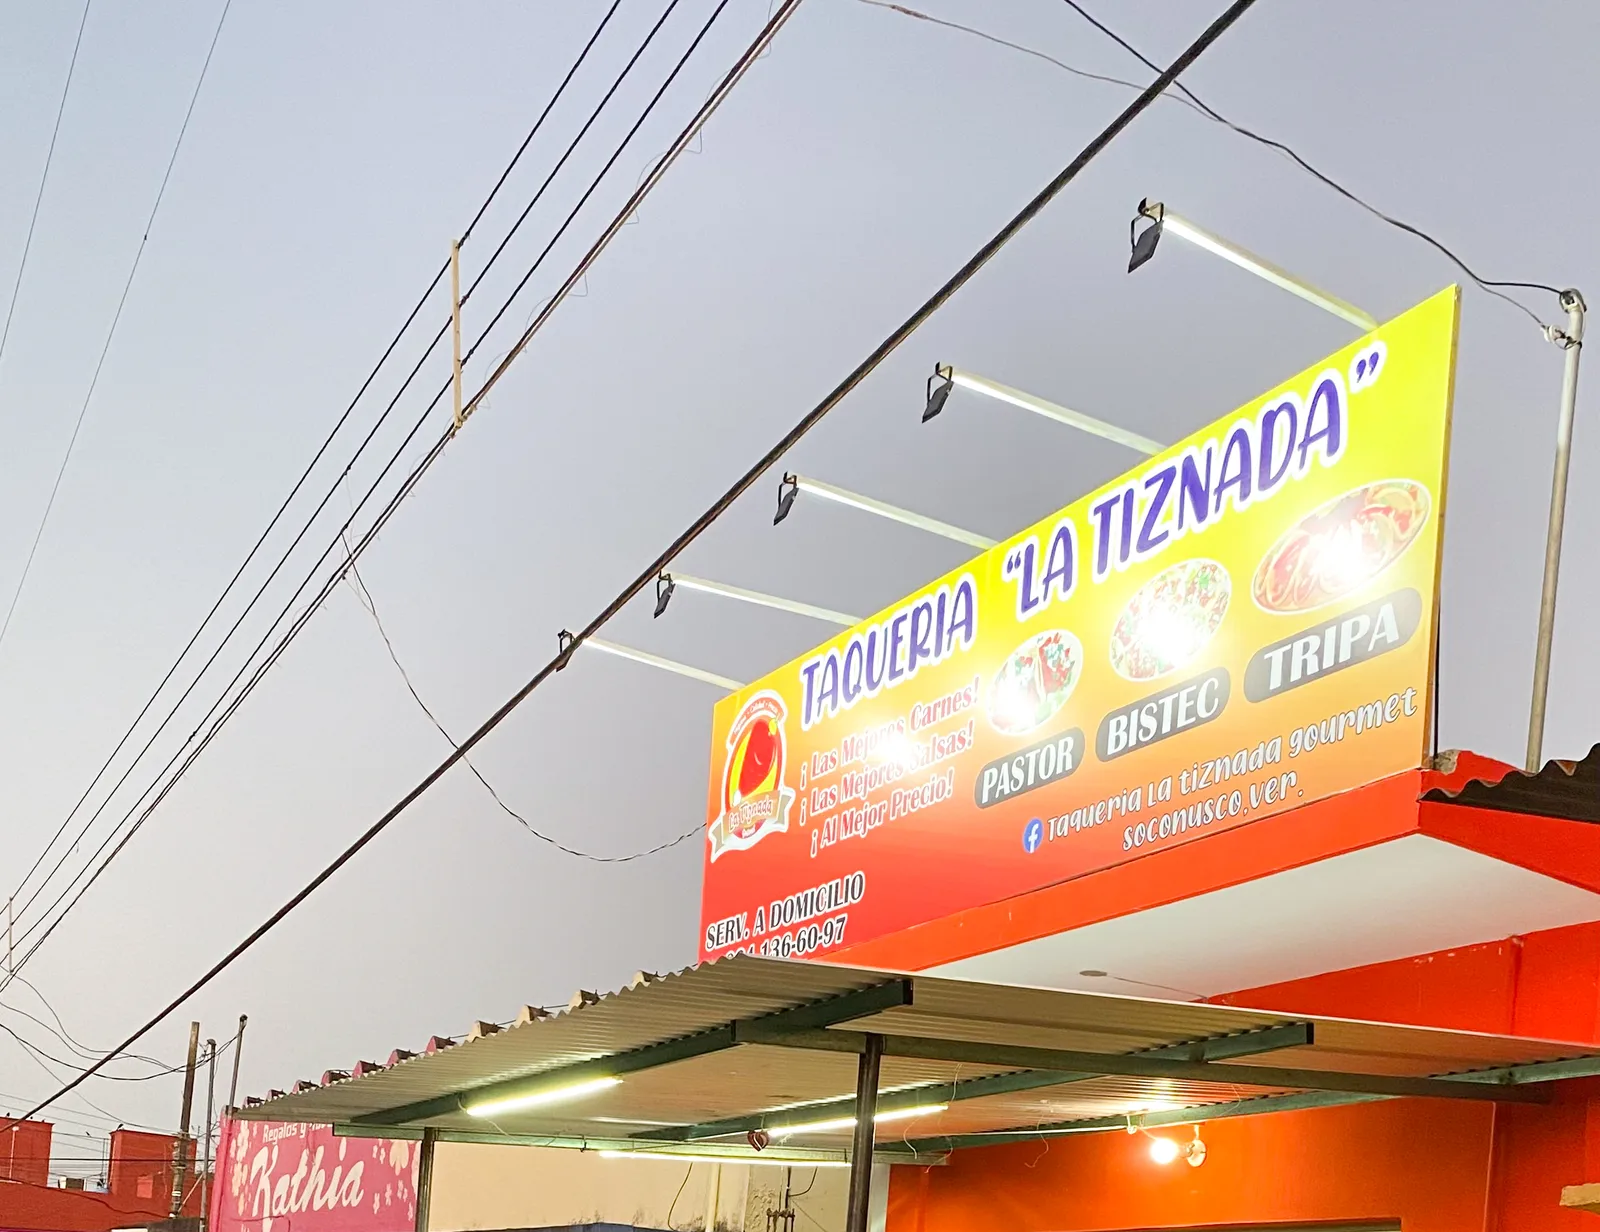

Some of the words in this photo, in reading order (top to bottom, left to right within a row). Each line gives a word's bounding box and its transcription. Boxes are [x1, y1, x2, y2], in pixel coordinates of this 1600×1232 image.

[803, 580, 974, 725] TAQUERIA
[1264, 602, 1400, 691] TRIPA
[812, 751, 837, 778] Las
[843, 718, 904, 766] Mejores
[910, 676, 980, 731] Carnes!
[1107, 677, 1219, 756] BISTEC
[812, 786, 837, 813] Las
[842, 761, 904, 801] Mejores
[909, 720, 974, 771] Salsas!
[982, 736, 1075, 804] PASTOR
[1048, 787, 1142, 842] Taqueria
[1178, 735, 1282, 797] tiznada
[1289, 687, 1418, 758] gourmet
[821, 816, 836, 847] Al
[841, 801, 886, 838] Mejor
[890, 769, 954, 819] Precio!
[706, 913, 749, 949] SERV.
[754, 908, 765, 935] A
[770, 873, 864, 929] DOMICILIO
[761, 916, 846, 957] 136-60-97
[263, 1122, 298, 1145] Regalos
